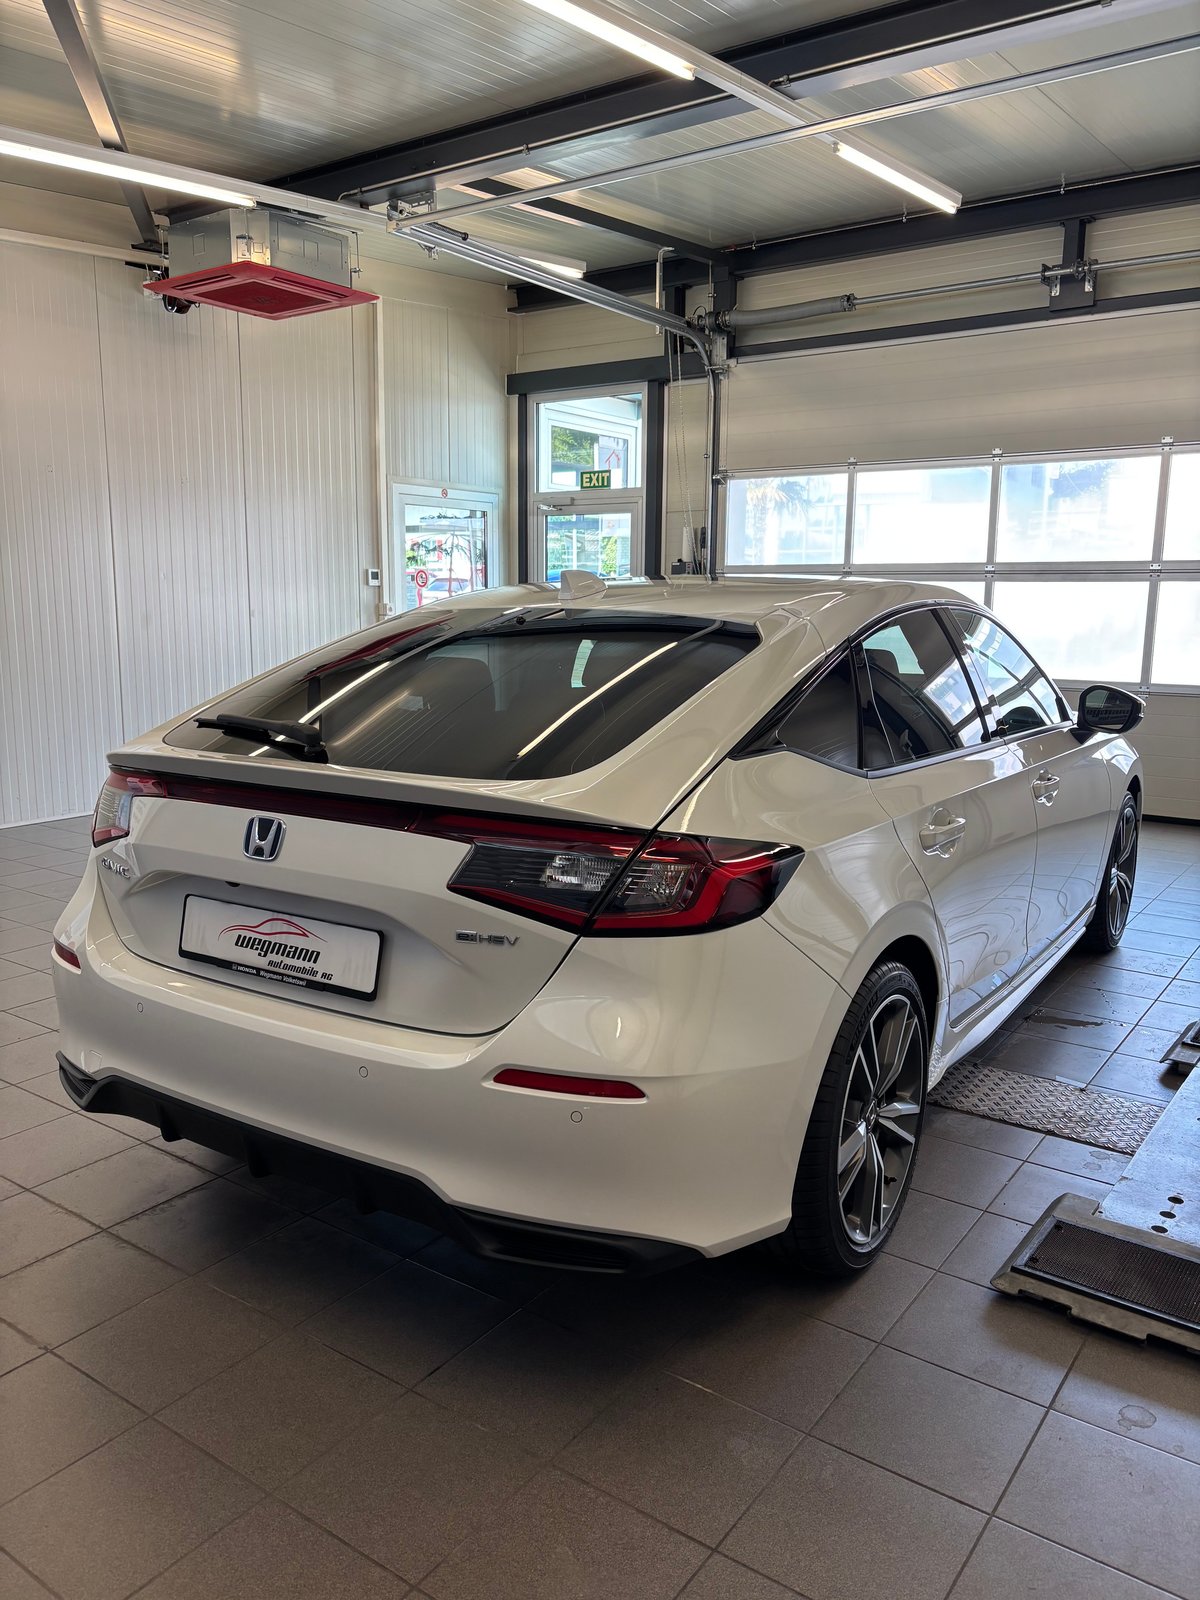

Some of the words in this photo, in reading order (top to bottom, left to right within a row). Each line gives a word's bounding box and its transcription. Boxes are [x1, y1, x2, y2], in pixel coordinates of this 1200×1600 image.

[582, 472, 609, 487] EXIT
[235, 934, 320, 964] wegmann
[237, 965, 257, 974] HONDA
[260, 970, 282, 980] Wegmann
[267, 960, 318, 977] automobile
[320, 972, 333, 981] AG
